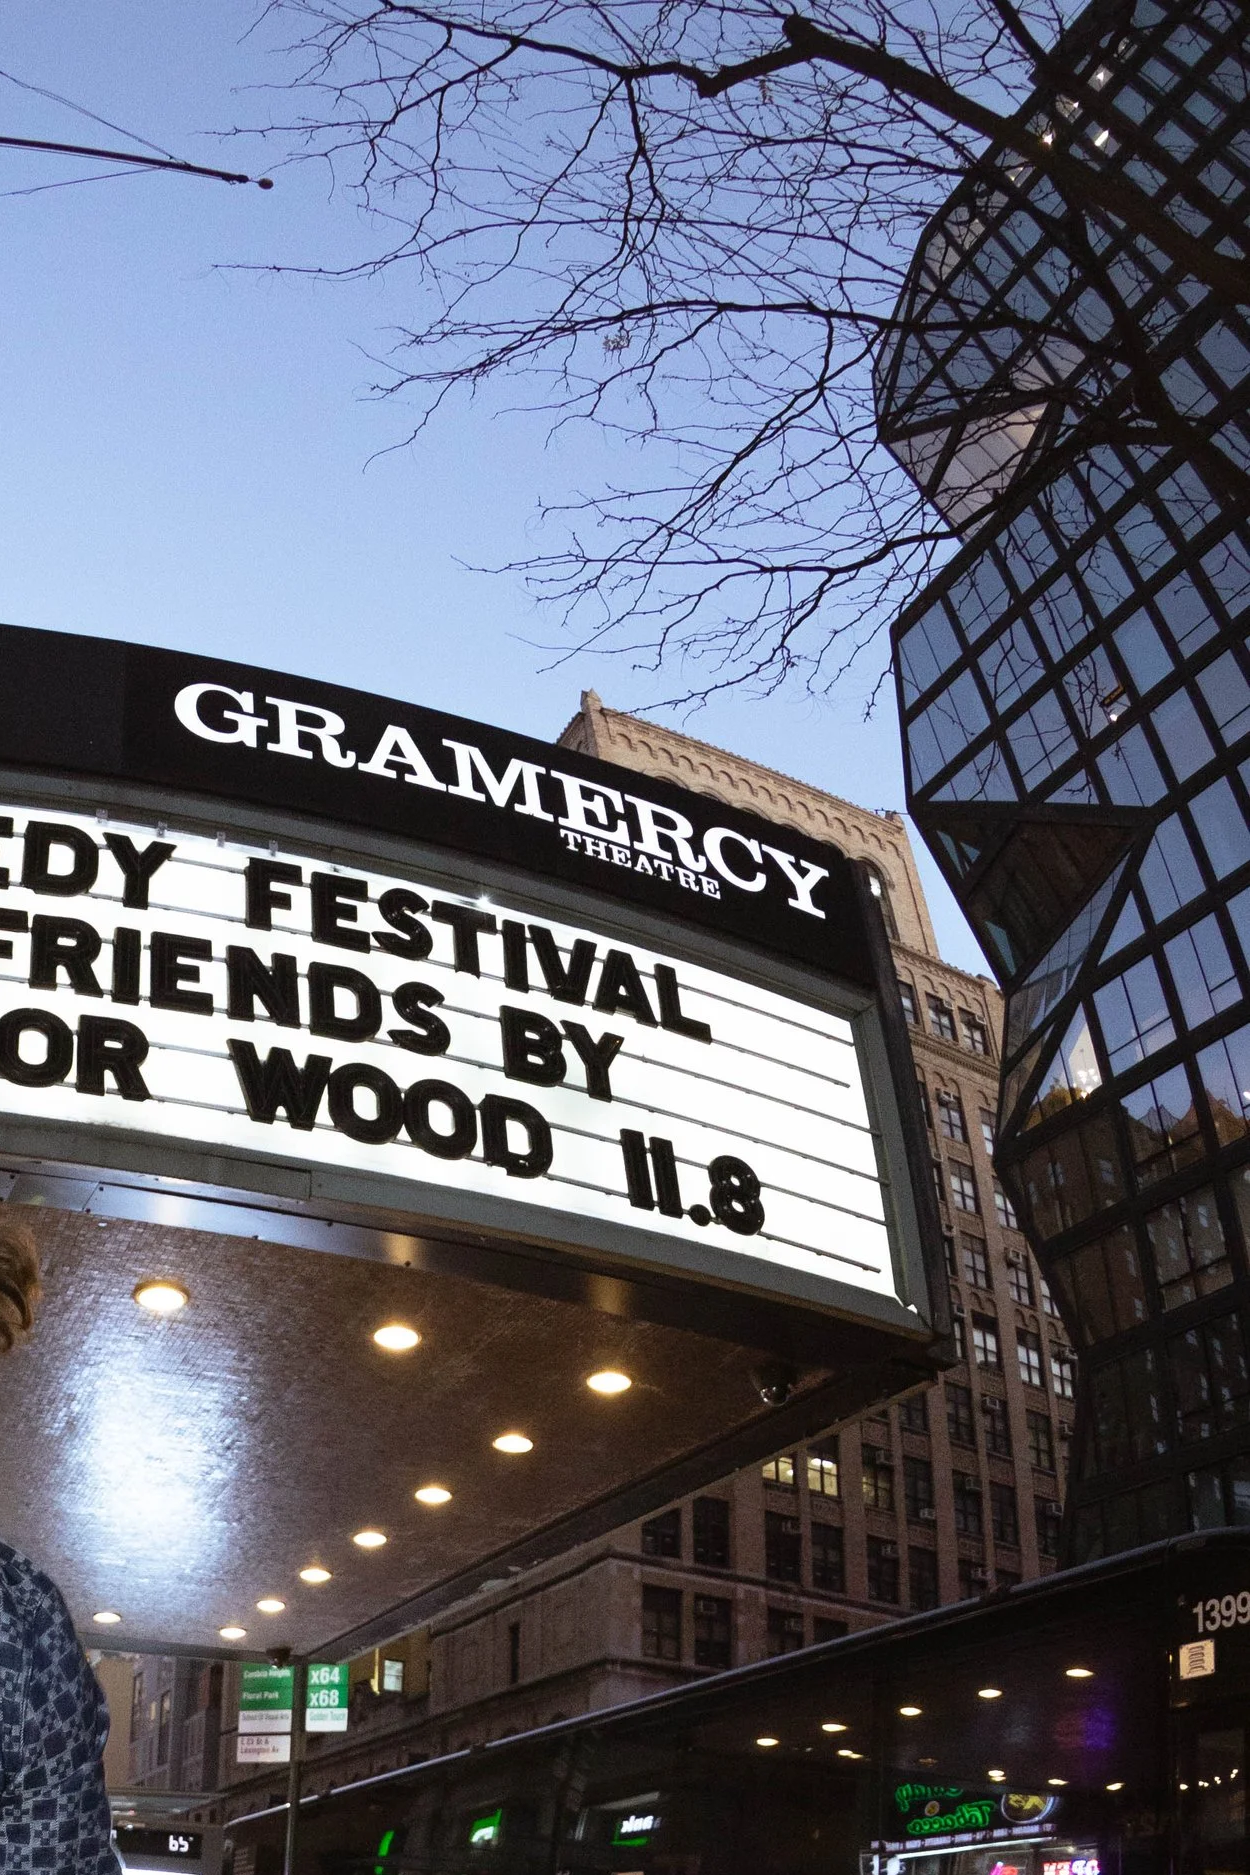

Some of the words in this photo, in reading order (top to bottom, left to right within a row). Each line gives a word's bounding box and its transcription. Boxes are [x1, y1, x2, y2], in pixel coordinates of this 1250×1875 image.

[174, 682, 831, 919] GRAMERCY
[559, 828, 722, 900] THEATRE
[244, 855, 713, 1044] FESTIVAL
[500, 1006, 625, 1103] BY
[226, 1039, 554, 1179] WOOD
[1192, 1591, 1250, 1633] 1399
[263, 1691, 279, 1699] Park
[310, 1690, 339, 1707] x68
[311, 1667, 340, 1685] x64
